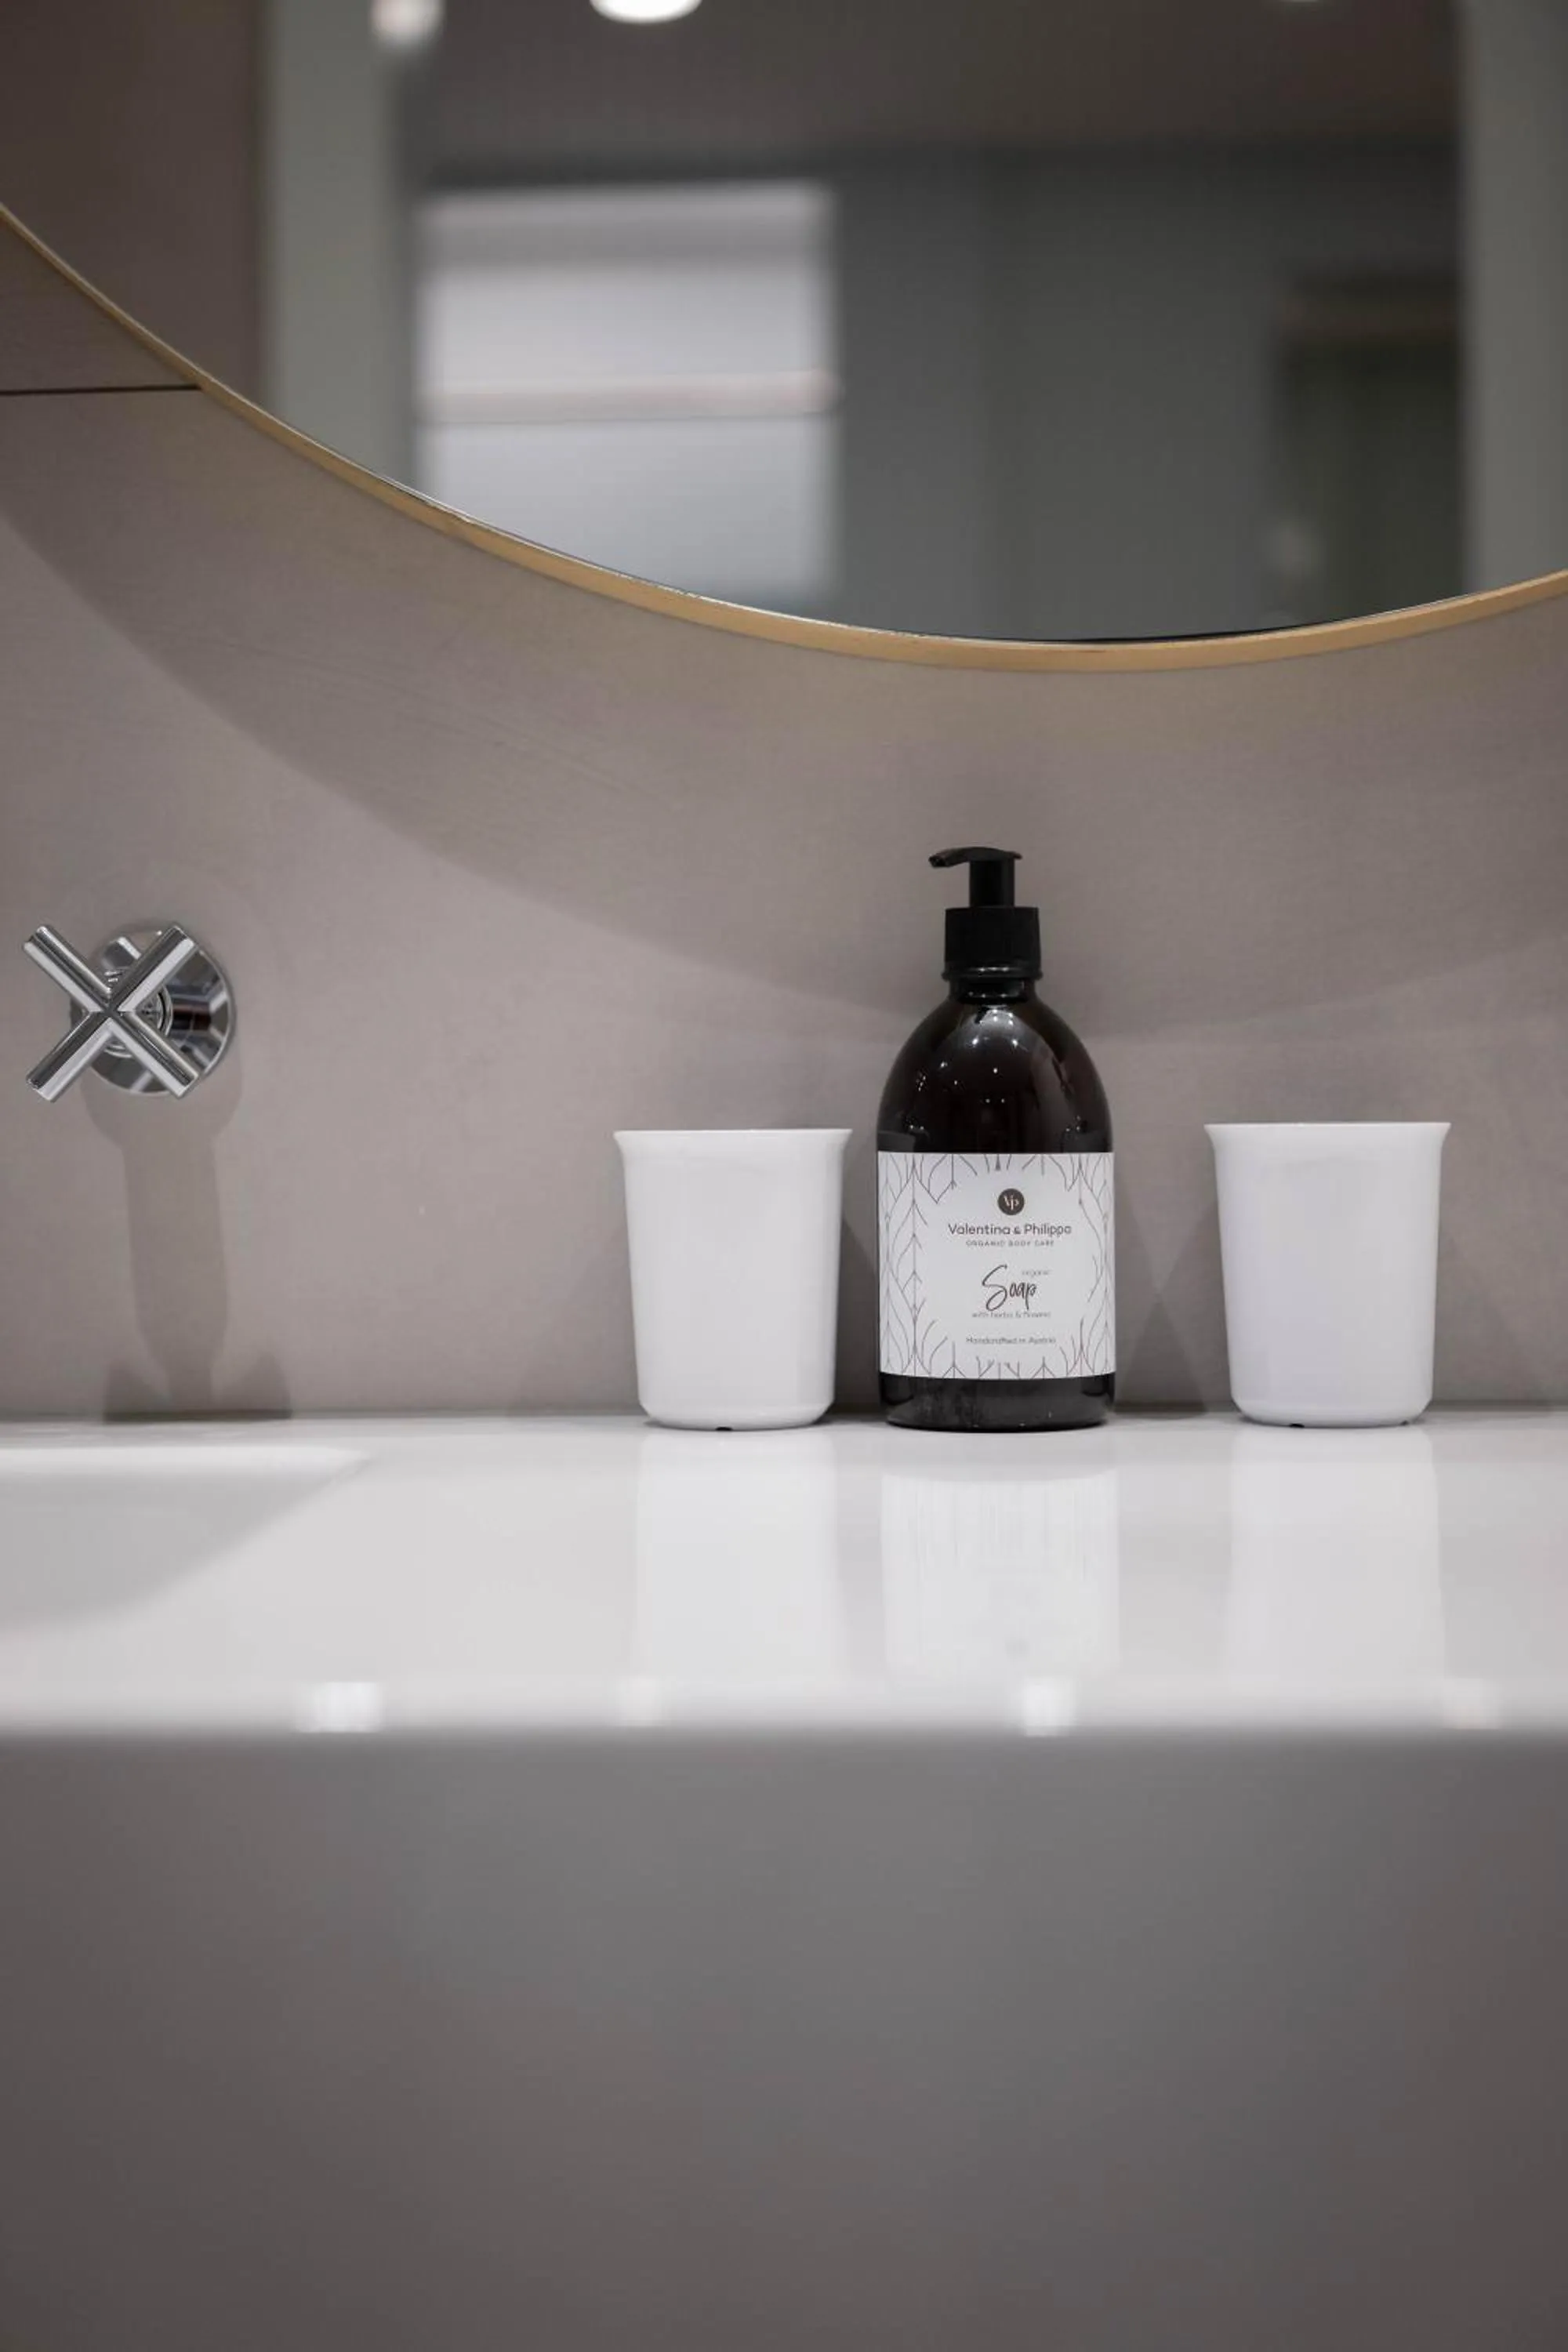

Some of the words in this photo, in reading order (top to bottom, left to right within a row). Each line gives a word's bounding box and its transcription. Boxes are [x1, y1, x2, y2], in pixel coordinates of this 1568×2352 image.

[948, 1223, 1011, 1236] Valentina
[1024, 1222, 1072, 1238] Philippa
[982, 1264, 1036, 1311] Soap
